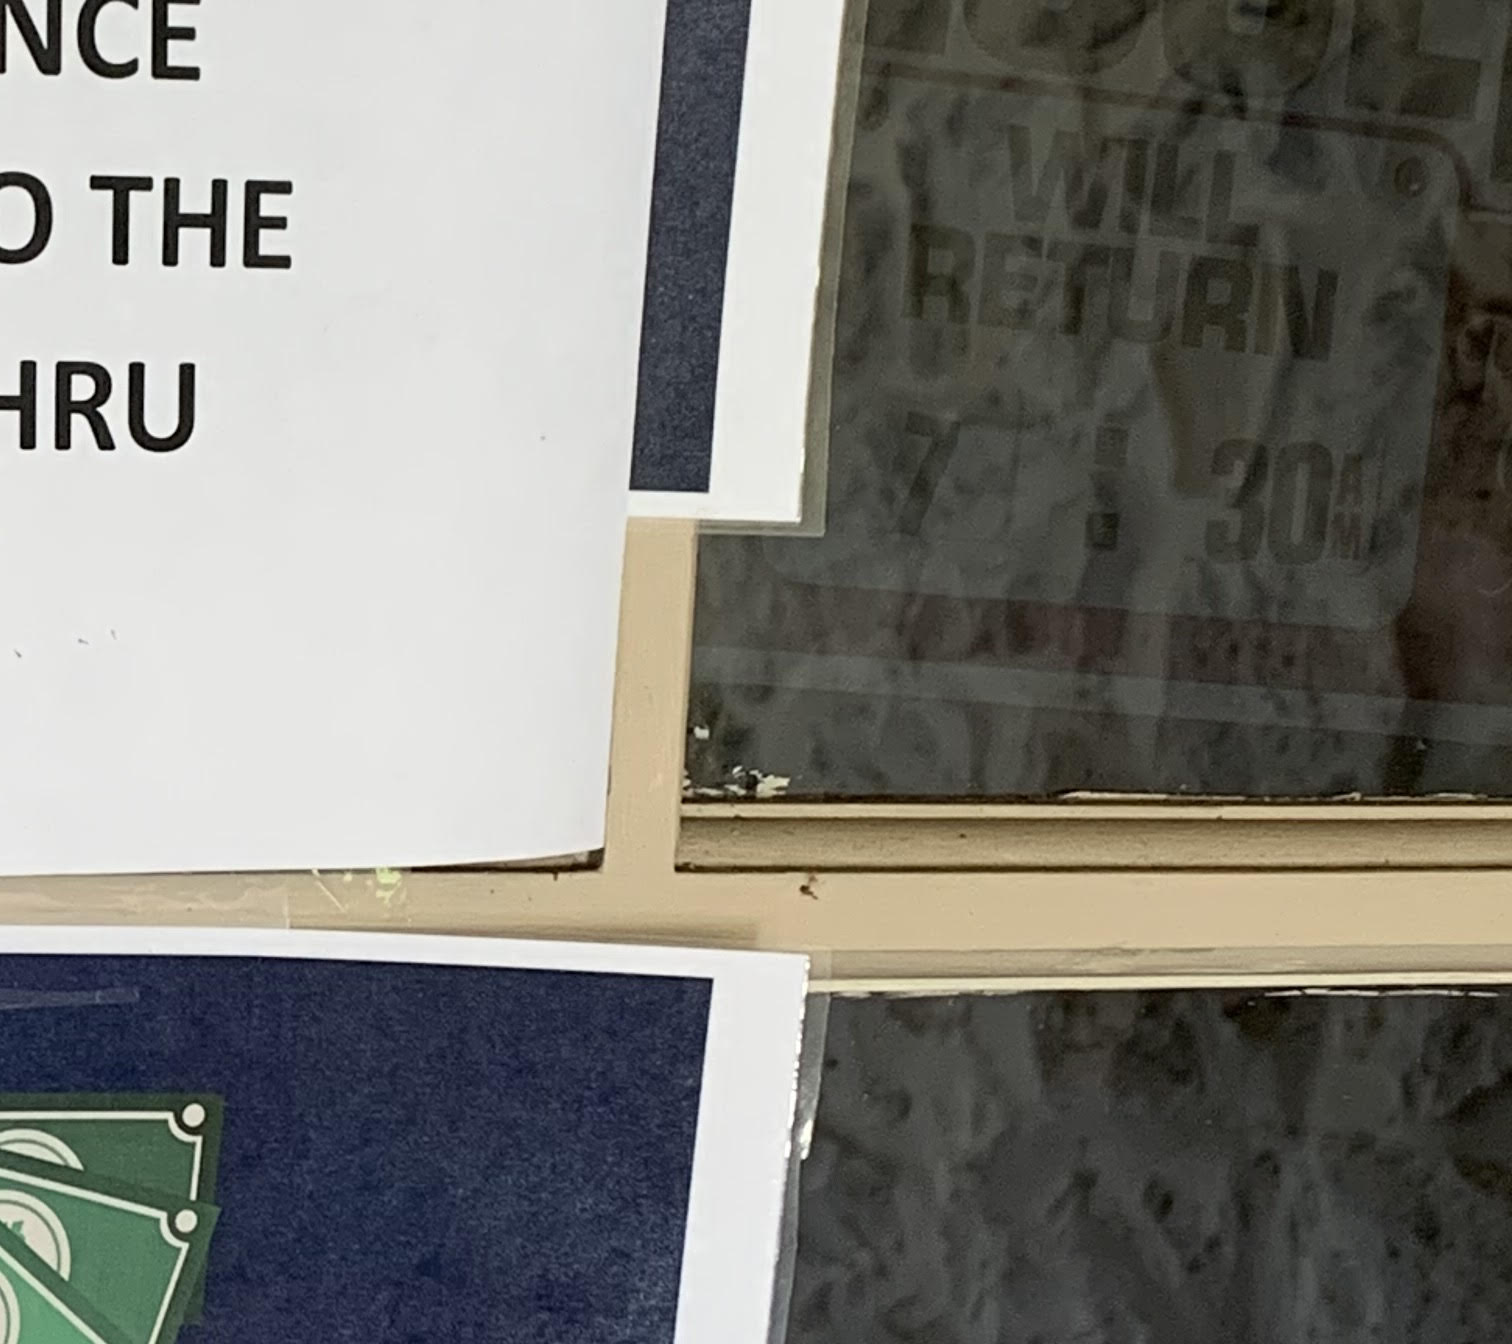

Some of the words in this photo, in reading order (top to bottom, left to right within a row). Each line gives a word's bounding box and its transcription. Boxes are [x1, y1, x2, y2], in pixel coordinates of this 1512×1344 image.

[86, 171, 296, 272] THE
[1002, 121, 1262, 250] WILL
[897, 220, 1342, 364] RETURN
